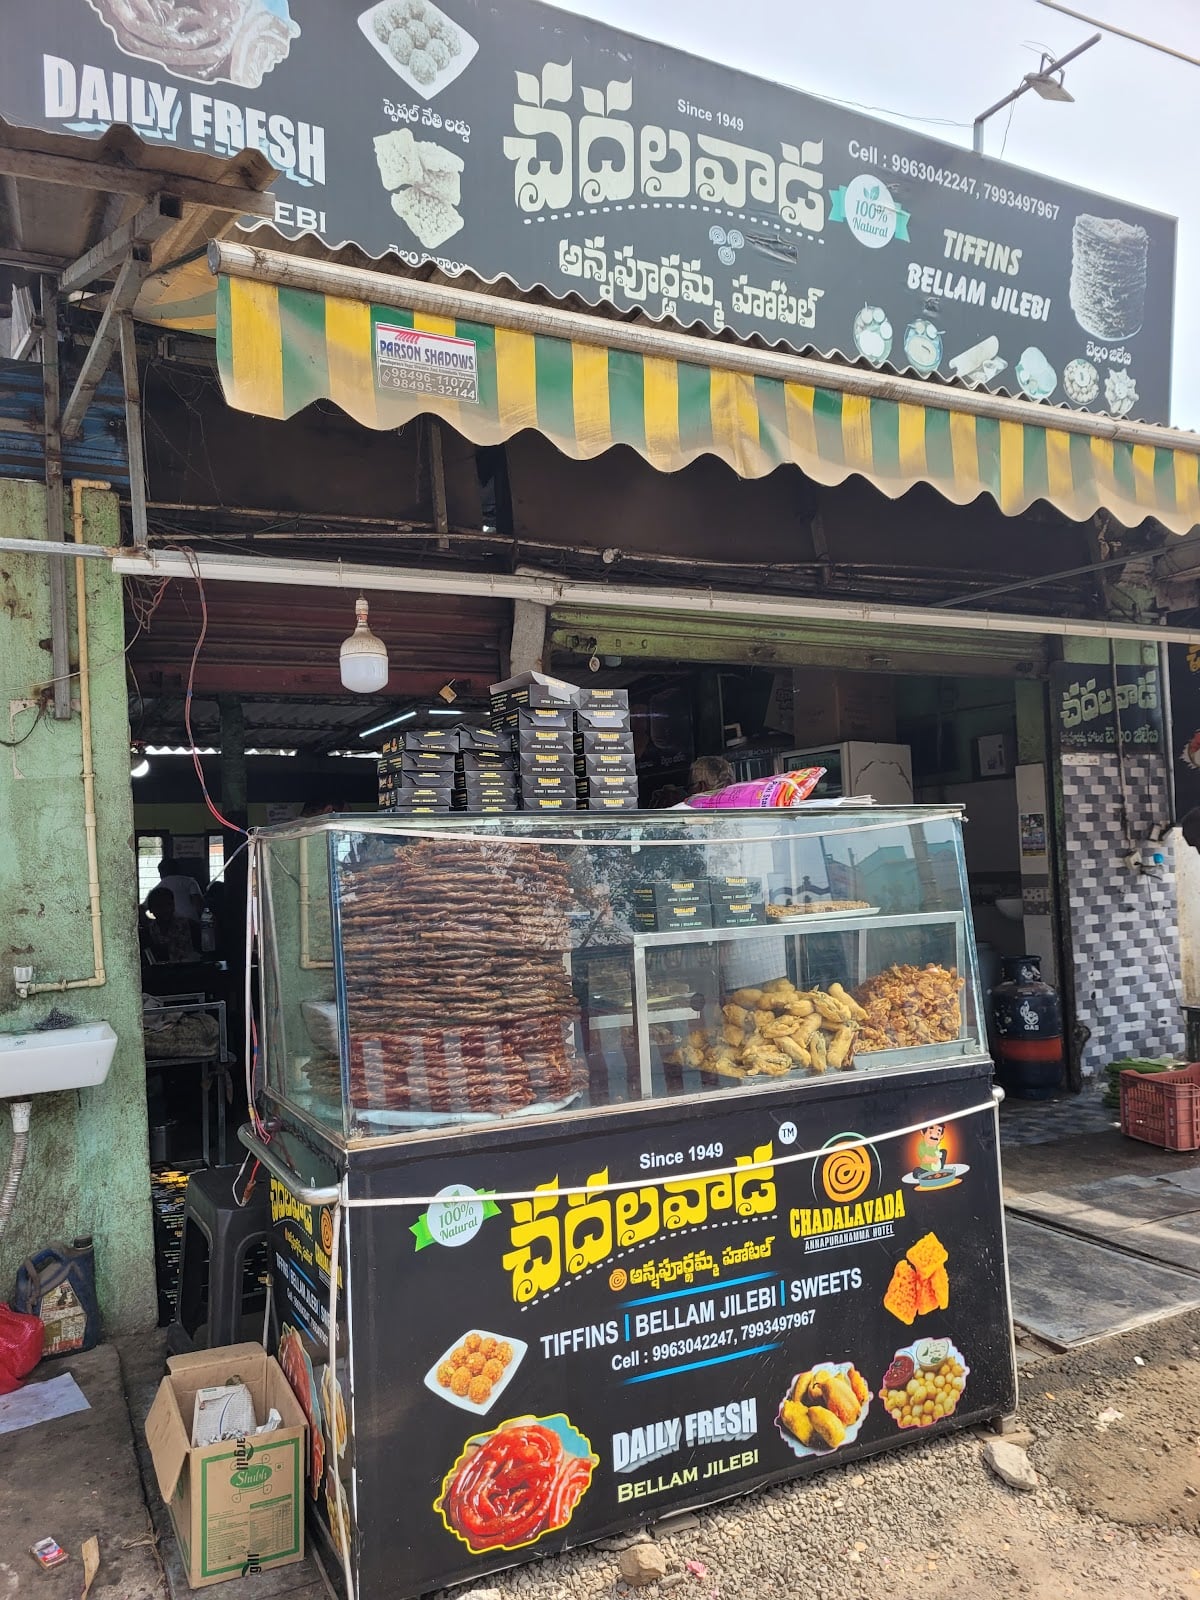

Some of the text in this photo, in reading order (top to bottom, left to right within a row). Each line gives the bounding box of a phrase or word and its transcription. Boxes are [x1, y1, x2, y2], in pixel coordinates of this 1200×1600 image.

[43, 54, 326, 186] DAILY FRESH
[677, 99, 744, 131] Since 1949
[503, 56, 824, 232] చదలవాడ
[848, 140, 878, 165] Cell
[891, 154, 981, 199] 9963042247,
[983, 183, 1061, 221] 7993497967
[274, 200, 327, 233] EBI
[852, 216, 889, 238] Natural
[855, 200, 888, 223] 100%
[943, 229, 1023, 276] TIFFINS
[907, 262, 1052, 322] BELLAM JILEBI
[380, 340, 421, 362] PARSON
[424, 348, 475, 371] SHADOWS
[390, 367, 474, 389] 98496-11077
[392, 378, 476, 399] 98495-32144
[781, 1127, 795, 1138] TM
[639, 1142, 724, 1169] Since 1949
[438, 1201, 474, 1229] 100%
[440, 1216, 478, 1241] Natural
[502, 1140, 777, 1303] చదలవాడ
[789, 1189, 905, 1238] CHADALAVADA
[804, 1224, 894, 1251] ANNAPURANAMMA HOTEL
[539, 1267, 863, 1359] TIFFINS BELLAM JILEBI SWEETS
[611, 1350, 640, 1370] Cell
[652, 1329, 738, 1361] 9963042247,
[740, 1309, 816, 1341] 7993497967
[612, 1397, 758, 1473] DAILY FRESH
[233, 1437, 249, 1471] argill
[617, 1449, 759, 1503] BELLAM JILEBI
